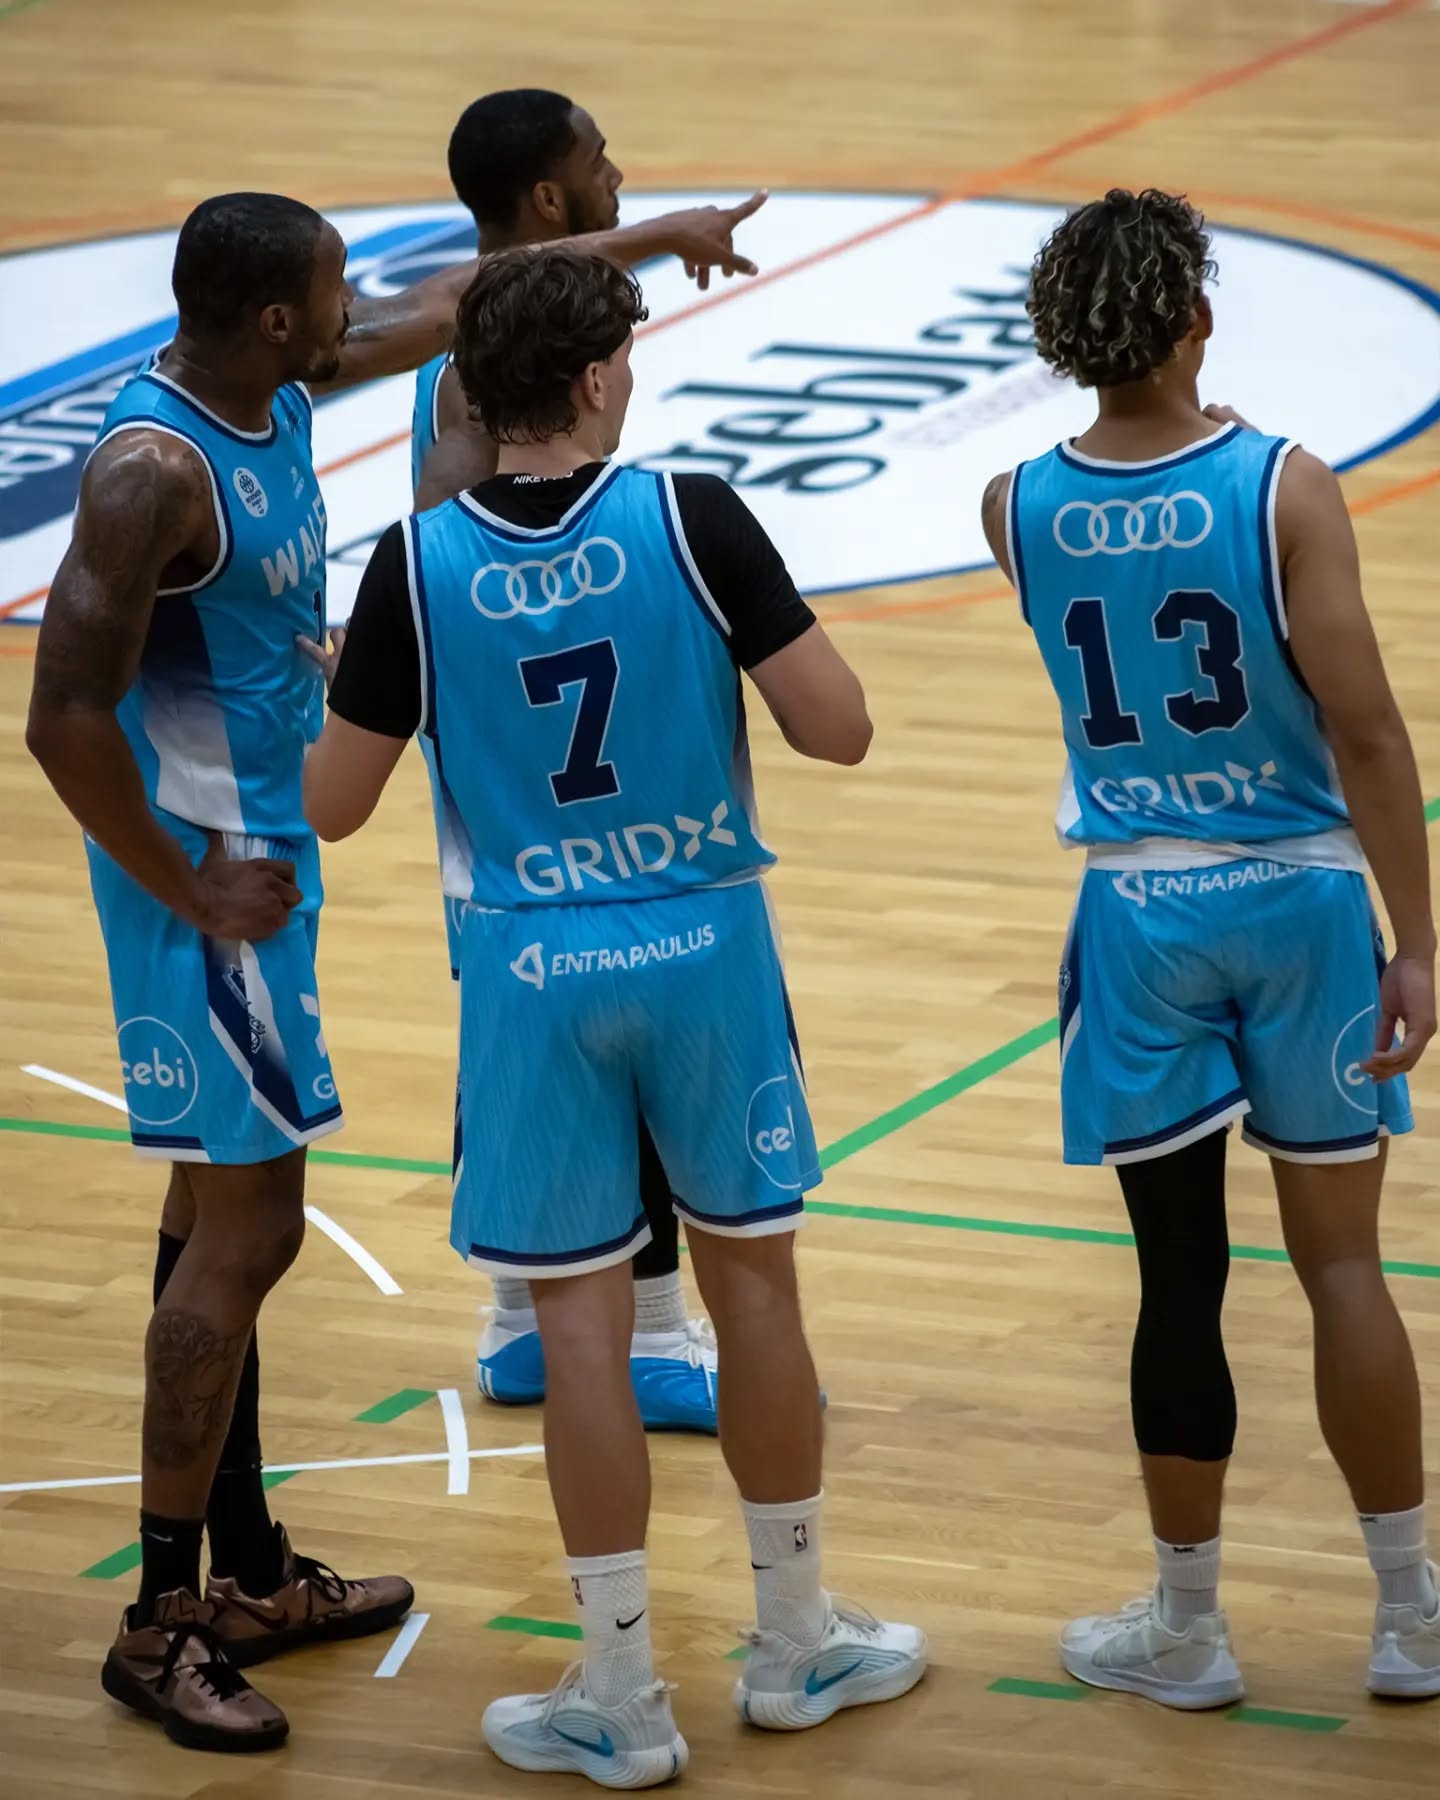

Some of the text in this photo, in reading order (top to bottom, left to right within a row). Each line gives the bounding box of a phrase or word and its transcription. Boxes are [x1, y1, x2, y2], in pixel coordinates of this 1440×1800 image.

[512, 474, 541, 485] NIKE
[1062, 588, 1251, 750] 13
[516, 636, 622, 807] 7
[1152, 861, 1308, 896] ENTRAPAUL
[551, 923, 715, 977] ENTRAPAULUS
[120, 1047, 186, 1089] cebi
